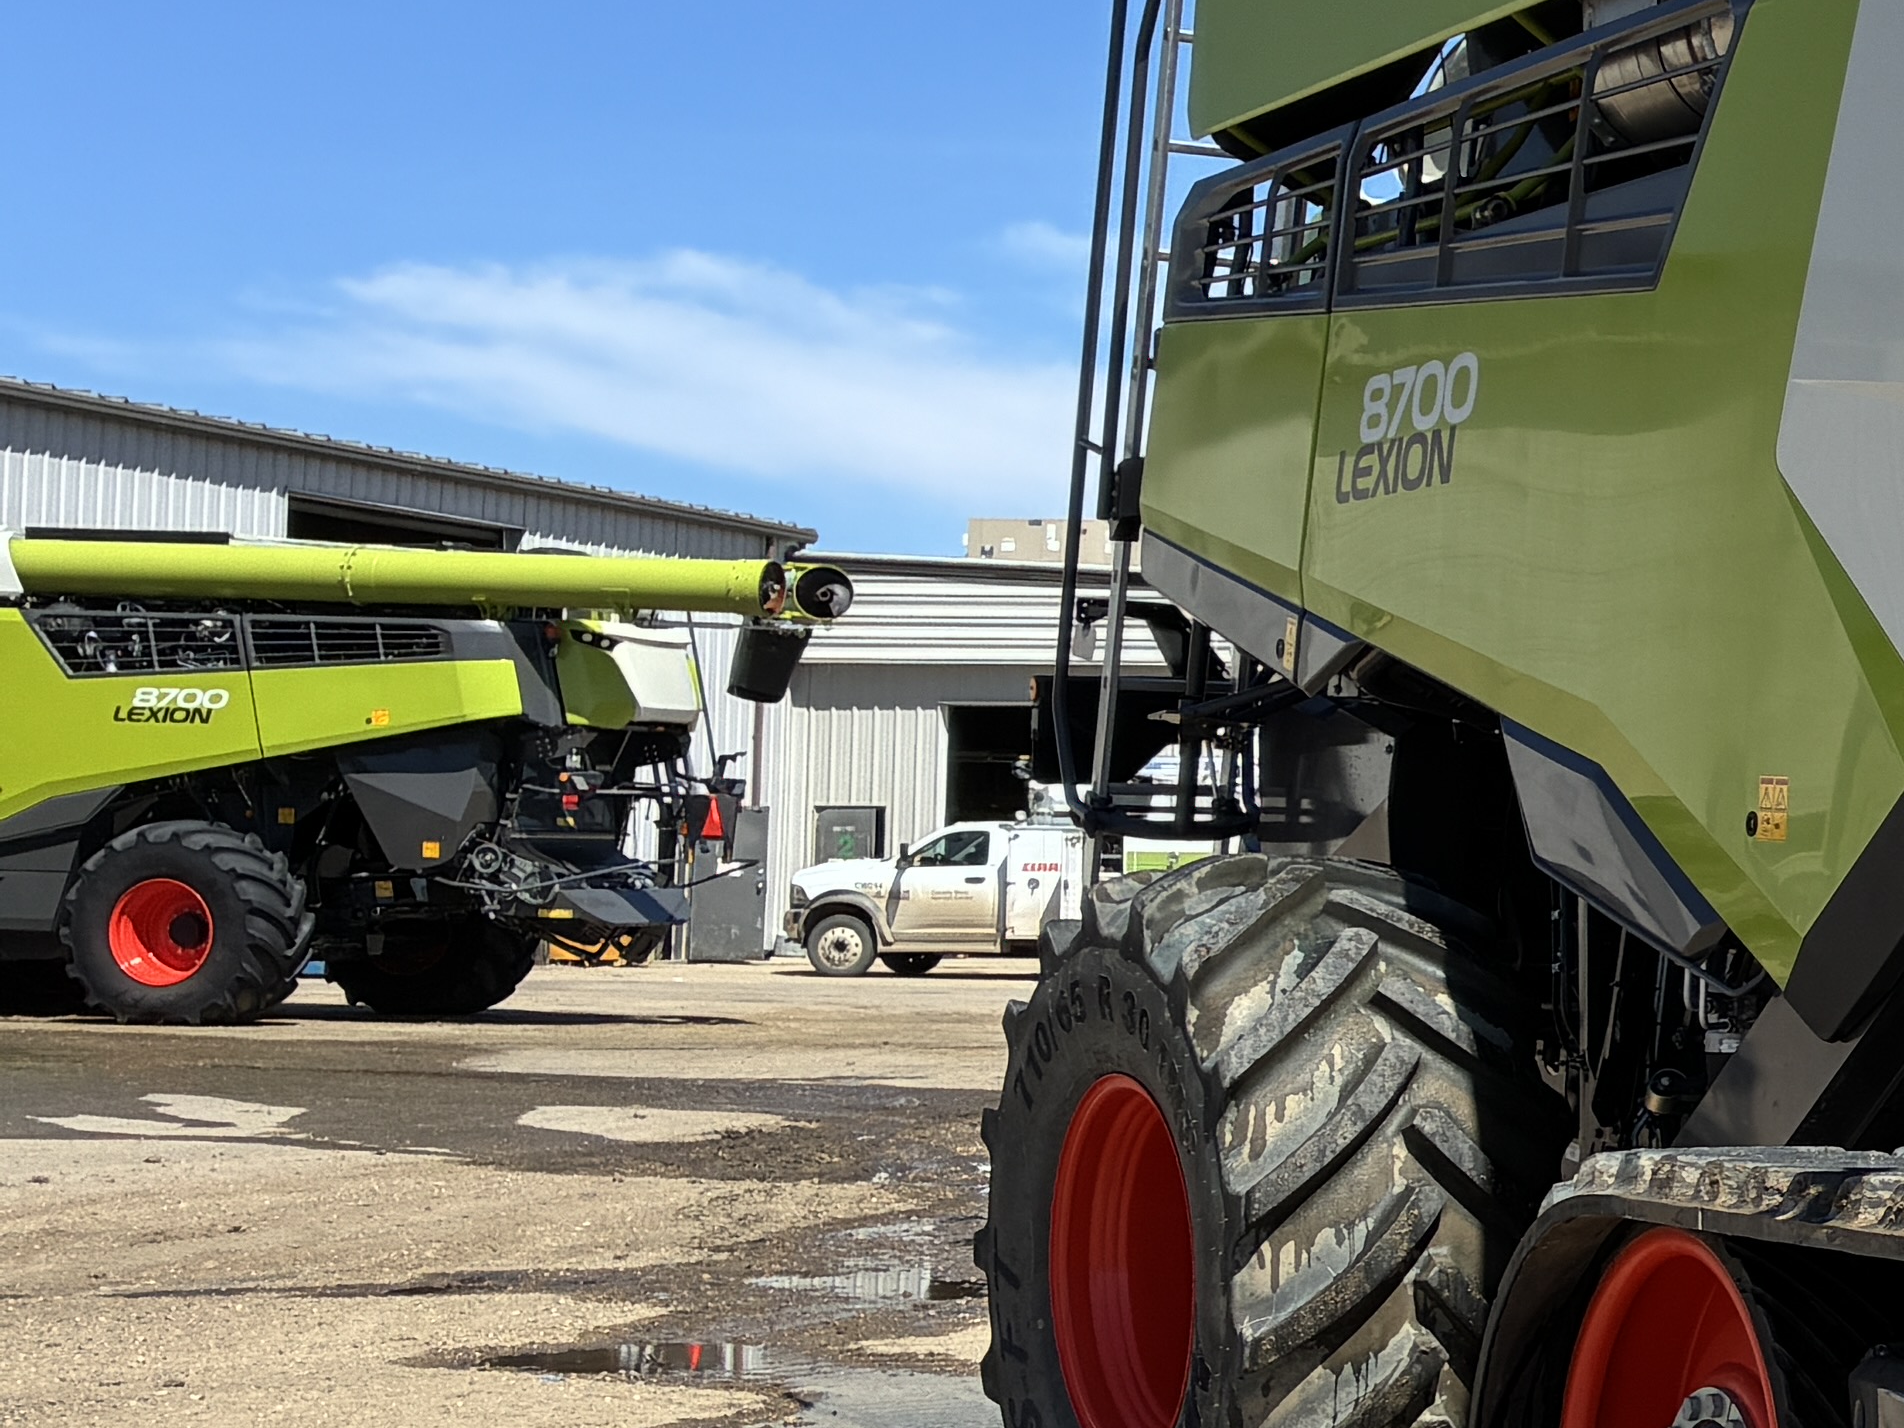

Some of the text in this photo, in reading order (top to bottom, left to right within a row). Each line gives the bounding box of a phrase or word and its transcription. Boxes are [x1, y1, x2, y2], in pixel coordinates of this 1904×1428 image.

[1359, 351, 1479, 444] 8700
[1336, 424, 1458, 505] LEXION
[132, 687, 230, 709] 8700
[113, 705, 214, 724] LEXION
[1022, 862, 1062, 872] CLAA
